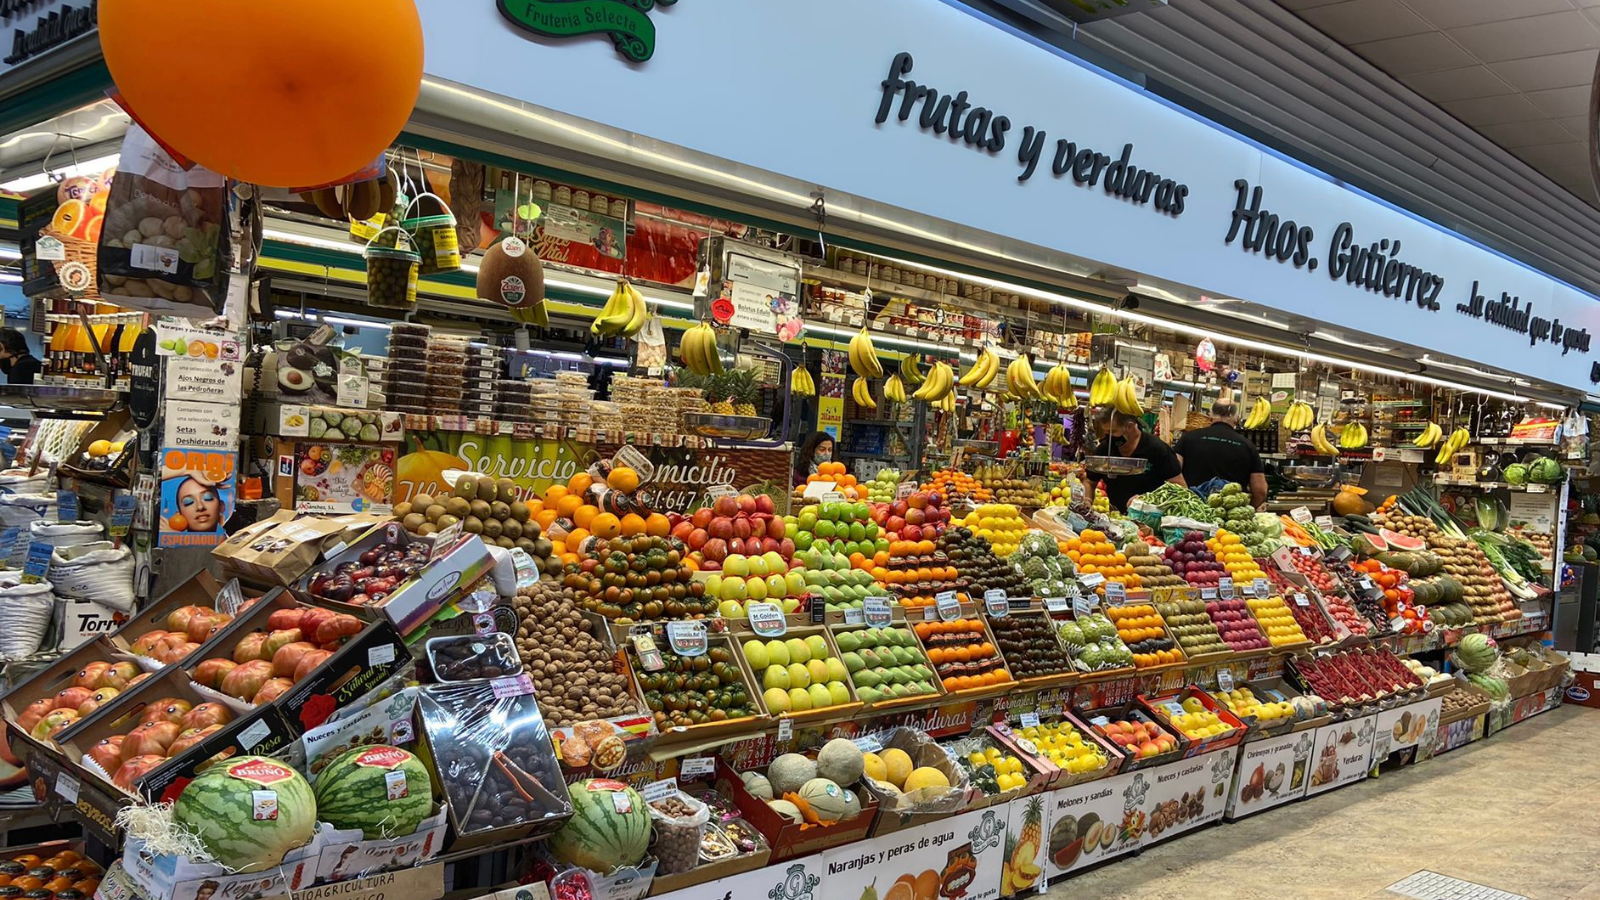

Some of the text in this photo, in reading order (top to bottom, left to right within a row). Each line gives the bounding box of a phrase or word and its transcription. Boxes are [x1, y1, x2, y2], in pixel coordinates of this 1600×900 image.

[584, 6, 636, 33] Selecta
[875, 52, 1189, 214] frutas y verduras
[1225, 179, 1444, 311] Hnos. Gutiérrez
[501, 280, 525, 293] Zespri
[1485, 292, 1532, 334] calidad
[1529, 317, 1551, 348] que
[1551, 318, 1563, 345] te
[1562, 328, 1591, 357] gusta
[178, 374, 192, 382] Ajos
[193, 375, 216, 384] Negros
[176, 426, 196, 434] Setas
[176, 438, 228, 446] Deshidratadas
[458, 441, 576, 480] Servicio
[1152, 676, 1184, 696] Frutas
[307, 712, 372, 744] Nueces y castañas
[903, 710, 968, 732] Verduras
[253, 736, 281, 757] Rosa
[1247, 748, 1270, 760] Chirimoyas
[1343, 754, 1364, 766] Verduras
[1156, 764, 1204, 784] Nueces y castañas
[1057, 788, 1113, 810] Melones y sandías
[828, 831, 955, 876] Naranjas y peras de agua
